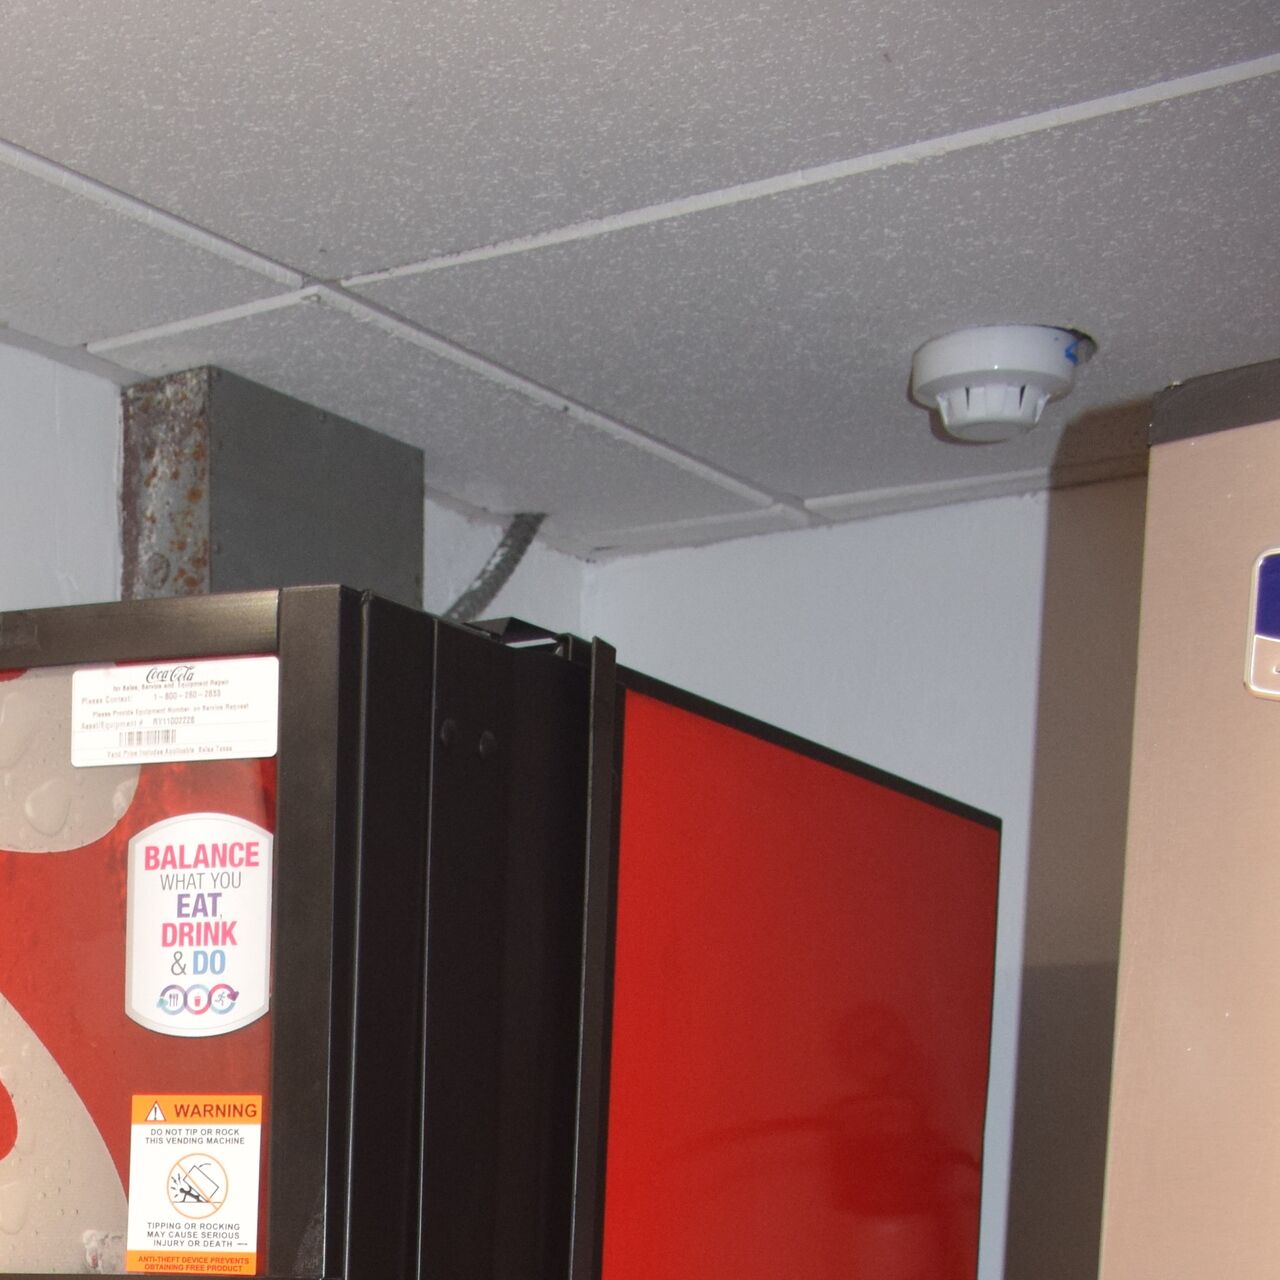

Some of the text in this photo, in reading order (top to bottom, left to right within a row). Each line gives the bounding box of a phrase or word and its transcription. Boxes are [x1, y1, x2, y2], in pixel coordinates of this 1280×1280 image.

[177, 680, 208, 691] Equipment
[81, 697, 103, 705] Please
[136, 707, 166, 717] Equipment
[144, 842, 260, 871] BALANCE
[160, 871, 242, 890] WHAT YOU
[177, 893, 223, 919] EAT,
[161, 921, 238, 947] DRINK
[171, 949, 226, 976] & DO
[174, 1103, 257, 1118] WARNING
[150, 1128, 240, 1136] DO NOT TIP OR ROCK
[145, 1137, 245, 1145] THIS VENDING MACHINE
[147, 1222, 240, 1231] TIPPING OR ROCKING
[147, 1231, 240, 1239] MAY CAUSE SERIOUS
[153, 1239, 185, 1247] INJURY
[188, 1239, 201, 1247] OR
[203, 1239, 233, 1247] DEATH
[138, 1256, 249, 1265] ANTI-THEFT DEVICE PREVENTS
